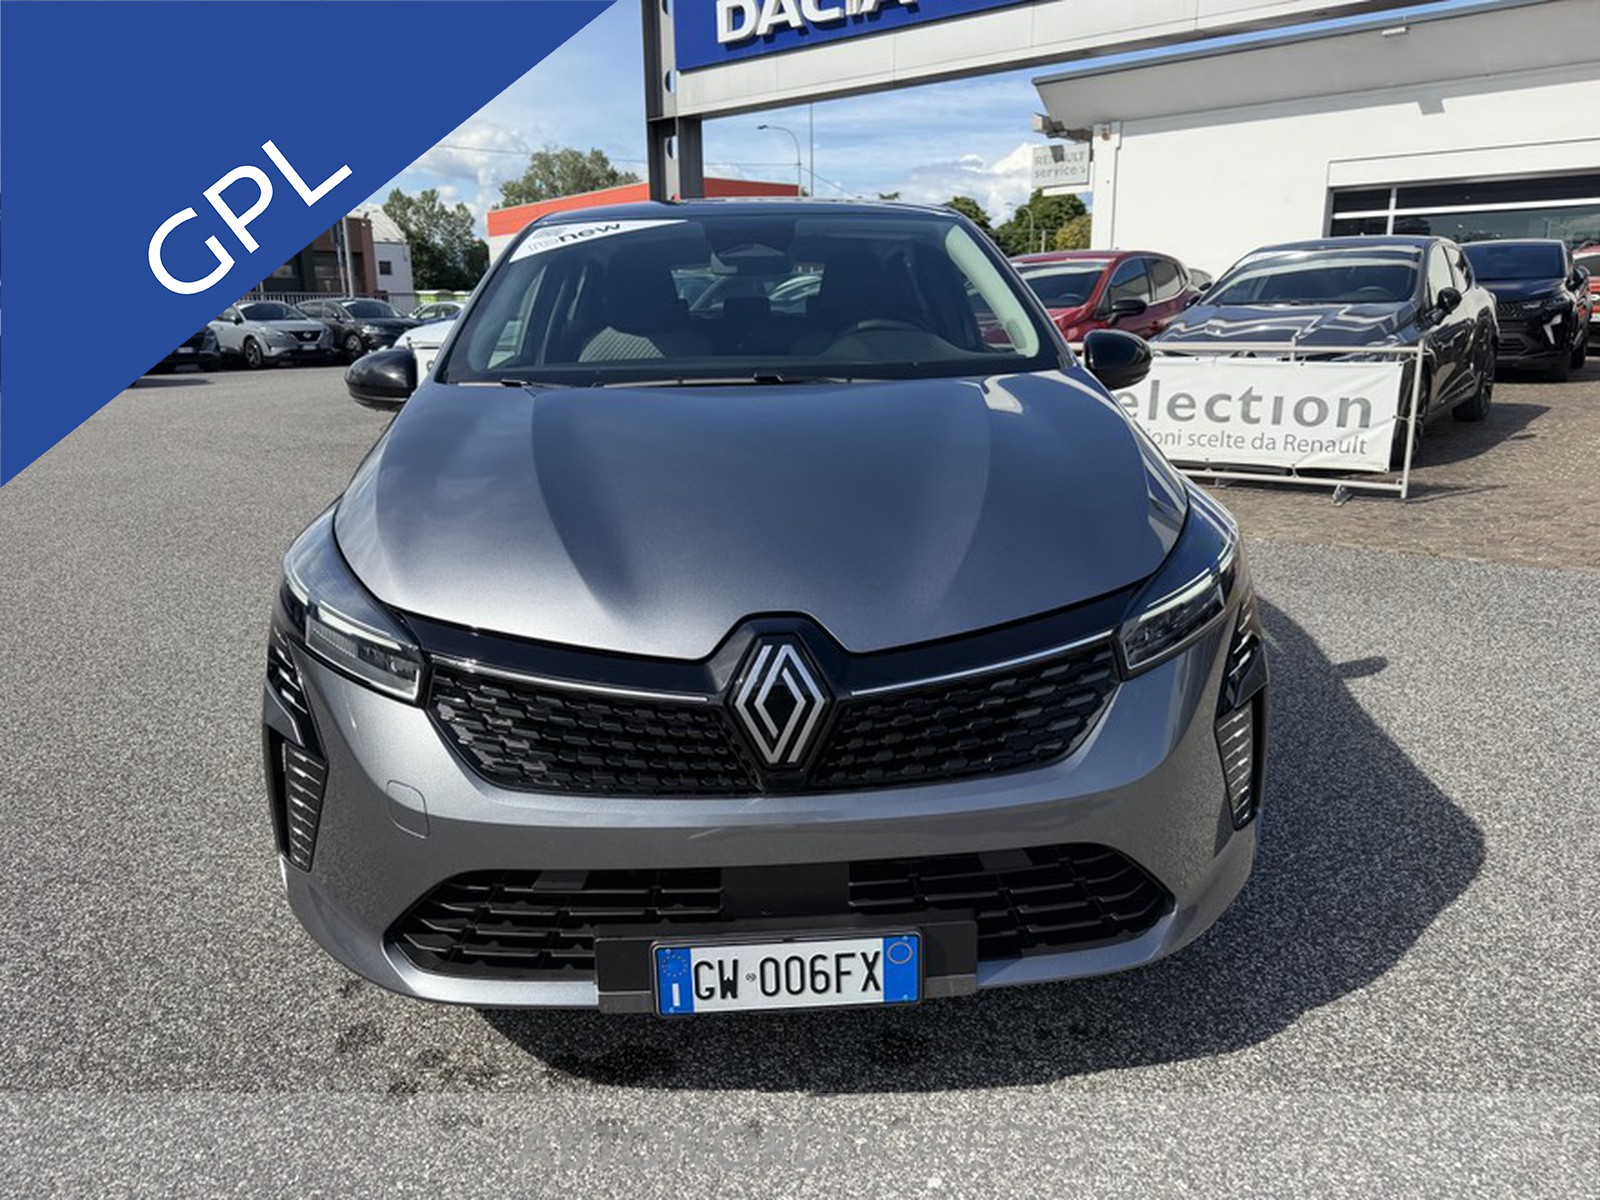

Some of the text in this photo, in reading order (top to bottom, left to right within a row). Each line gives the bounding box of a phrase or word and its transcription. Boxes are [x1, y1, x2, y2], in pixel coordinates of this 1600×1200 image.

[717, 0, 916, 43] DAC
[1035, 150, 1086, 165] REULT
[1034, 165, 1078, 179] service
[1146, 428, 1367, 456] oni scelte da Renault
[693, 950, 881, 1000] GW 006FX
